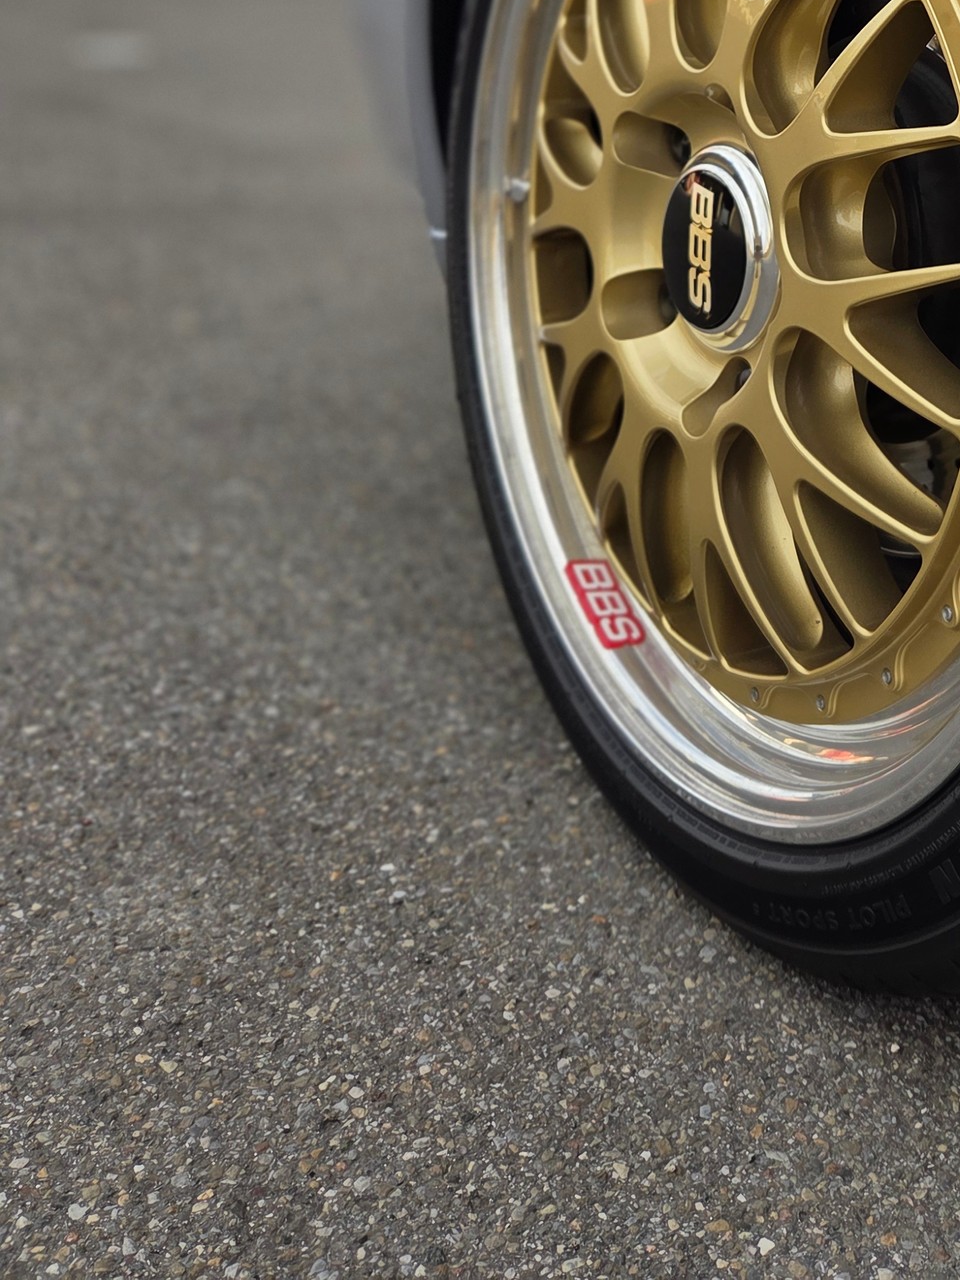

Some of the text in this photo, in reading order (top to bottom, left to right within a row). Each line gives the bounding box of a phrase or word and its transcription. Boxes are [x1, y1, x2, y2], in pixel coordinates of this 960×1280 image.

[688, 180, 714, 314] BBS
[572, 563, 643, 642] BBS
[768, 901, 839, 931] SPORT
[849, 894, 912, 931] PILOT
